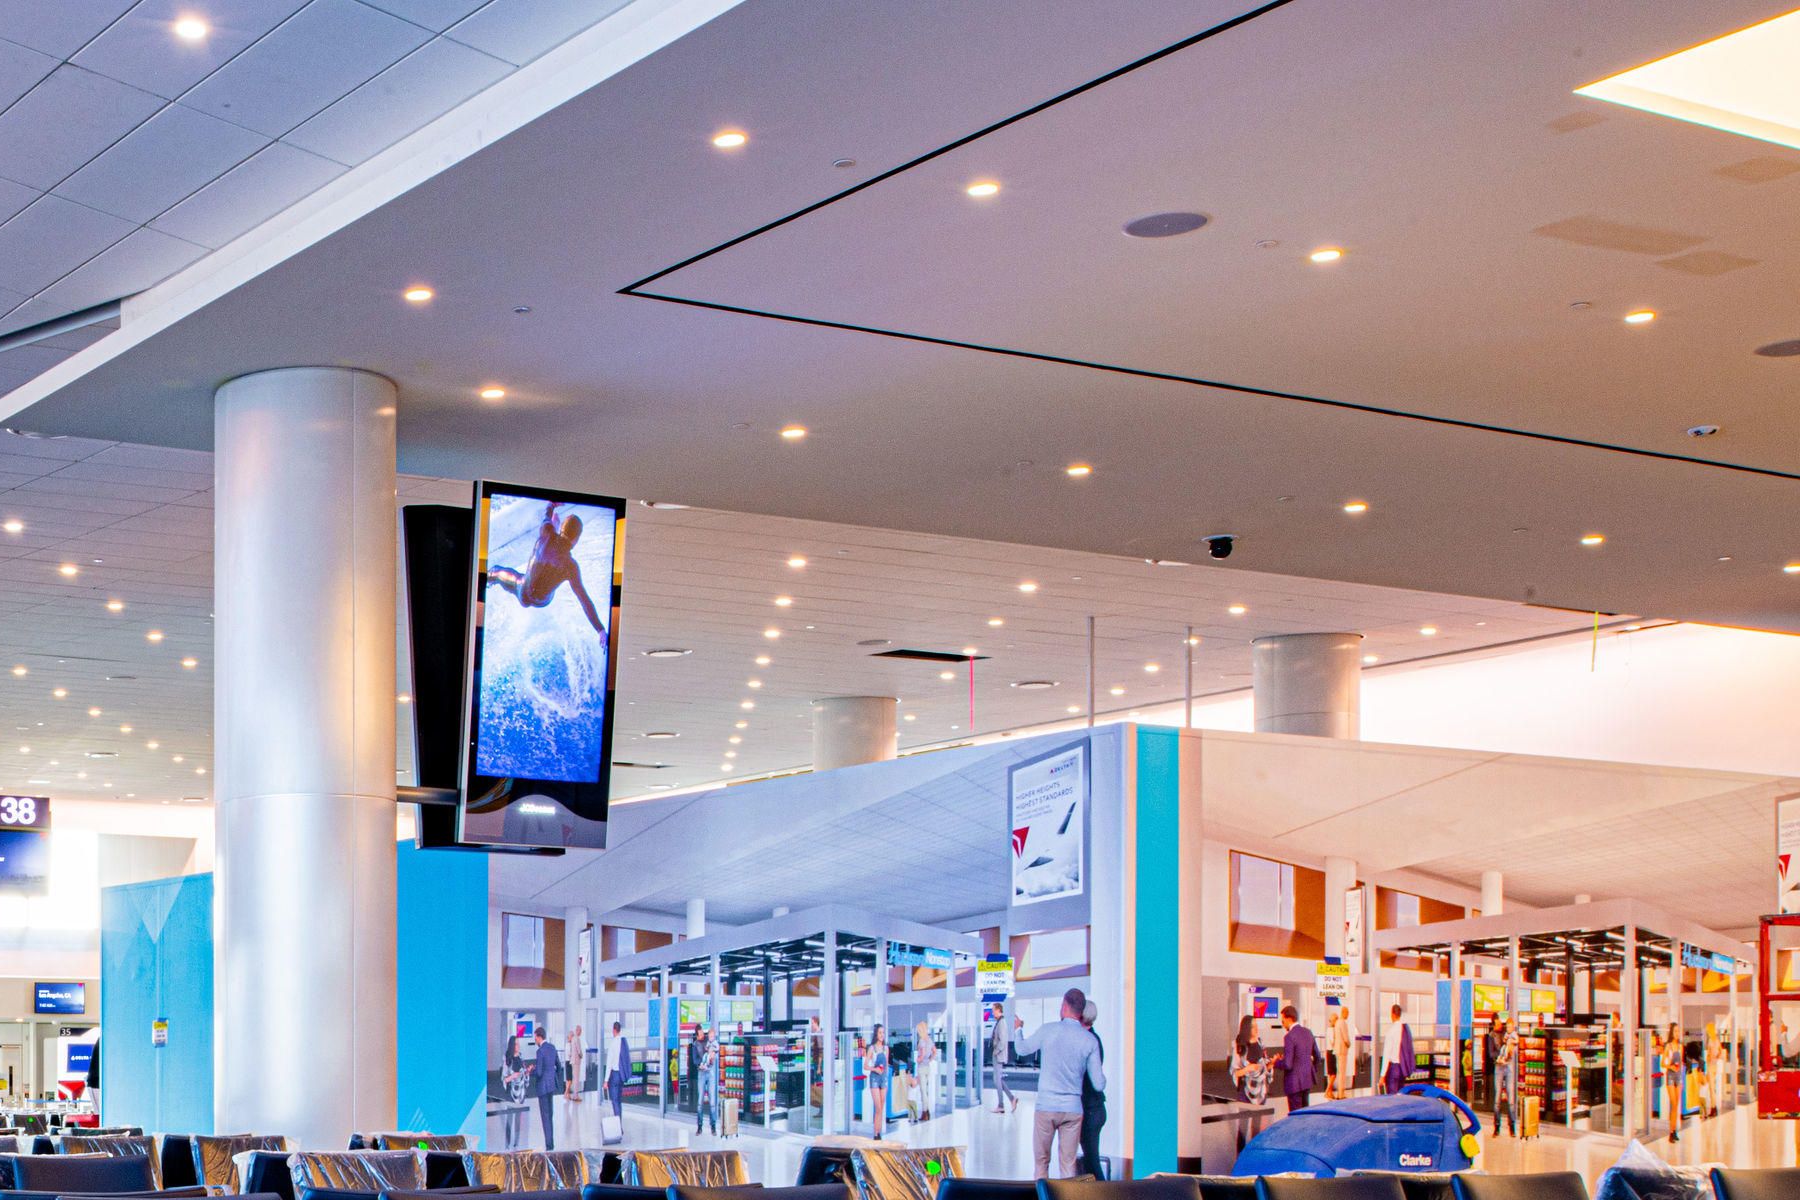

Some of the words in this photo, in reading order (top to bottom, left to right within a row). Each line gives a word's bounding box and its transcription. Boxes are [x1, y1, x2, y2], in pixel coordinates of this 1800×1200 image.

[1016, 789, 1035, 800] HIGHER
[1036, 782, 1060, 794] HEIGHTS
[1016, 798, 1038, 809] HIGHEST
[1040, 787, 1073, 803] STANDARDS
[0, 797, 36, 824] 38
[1399, 1154, 1432, 1166] Clarke
